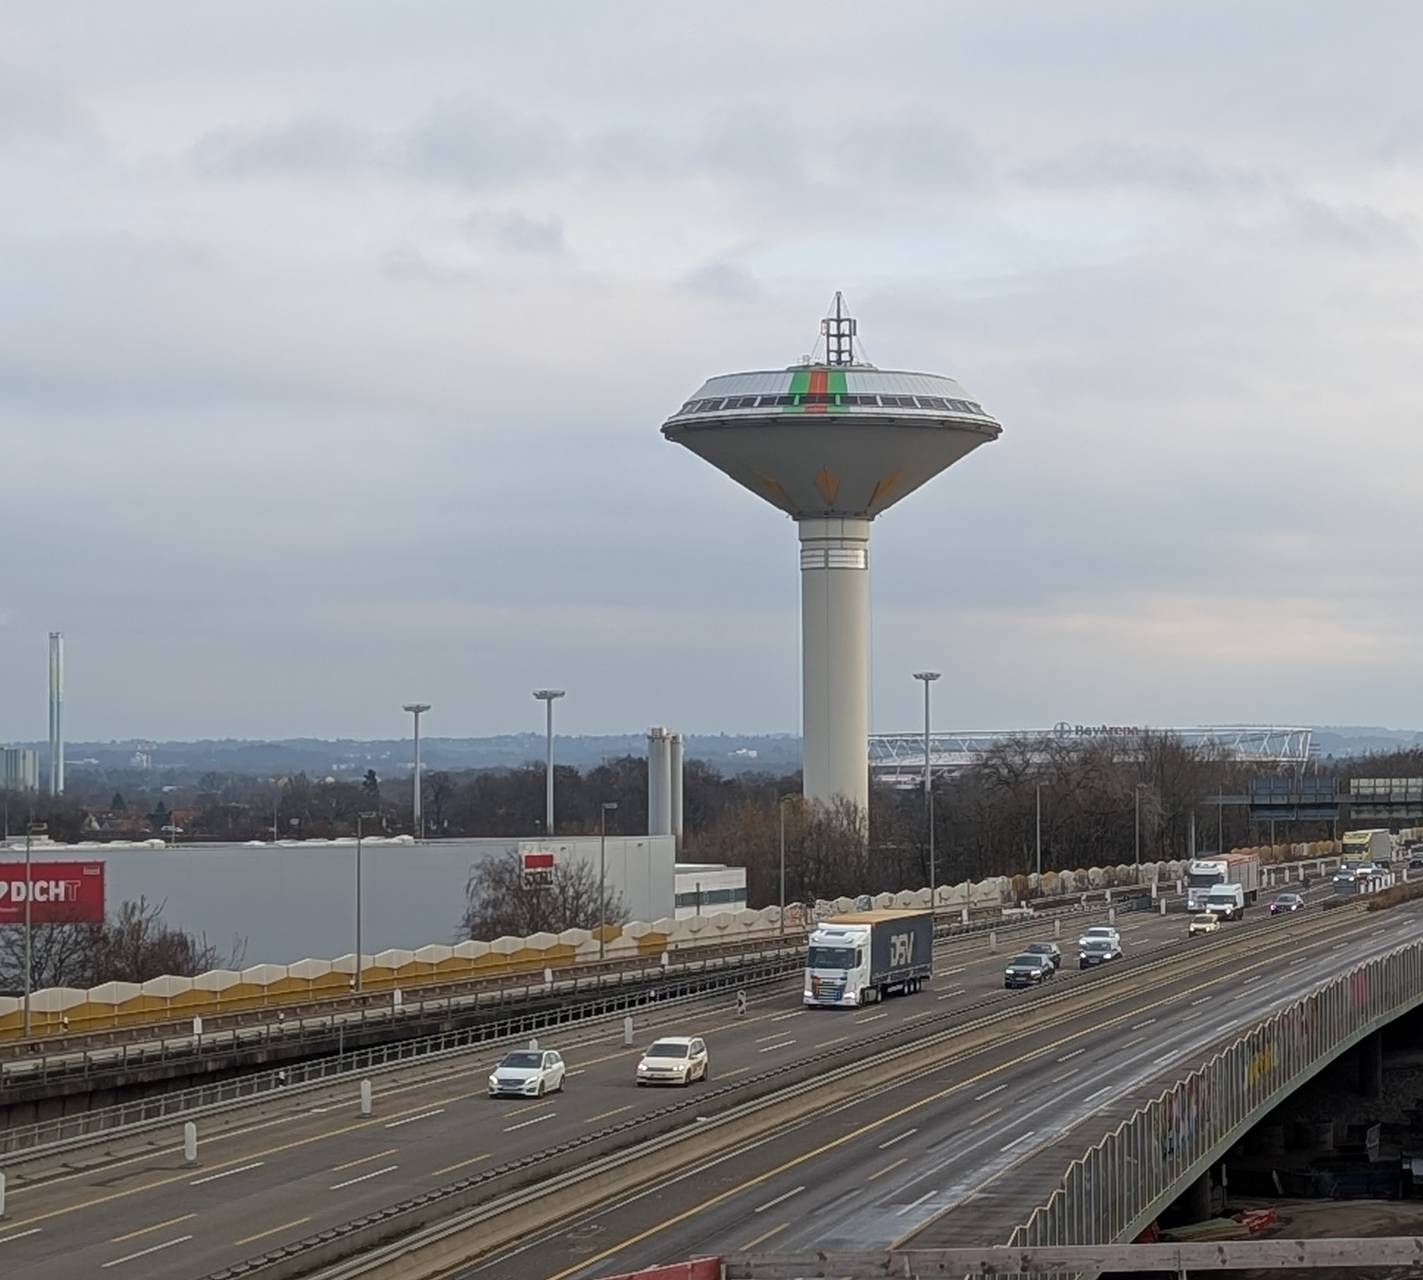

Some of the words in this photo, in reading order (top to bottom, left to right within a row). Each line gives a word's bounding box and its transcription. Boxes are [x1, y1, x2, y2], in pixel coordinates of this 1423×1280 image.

[1075, 724, 1139, 736] BayArena
[11, 880, 81, 902] DICHT
[890, 931, 914, 967] DSV
